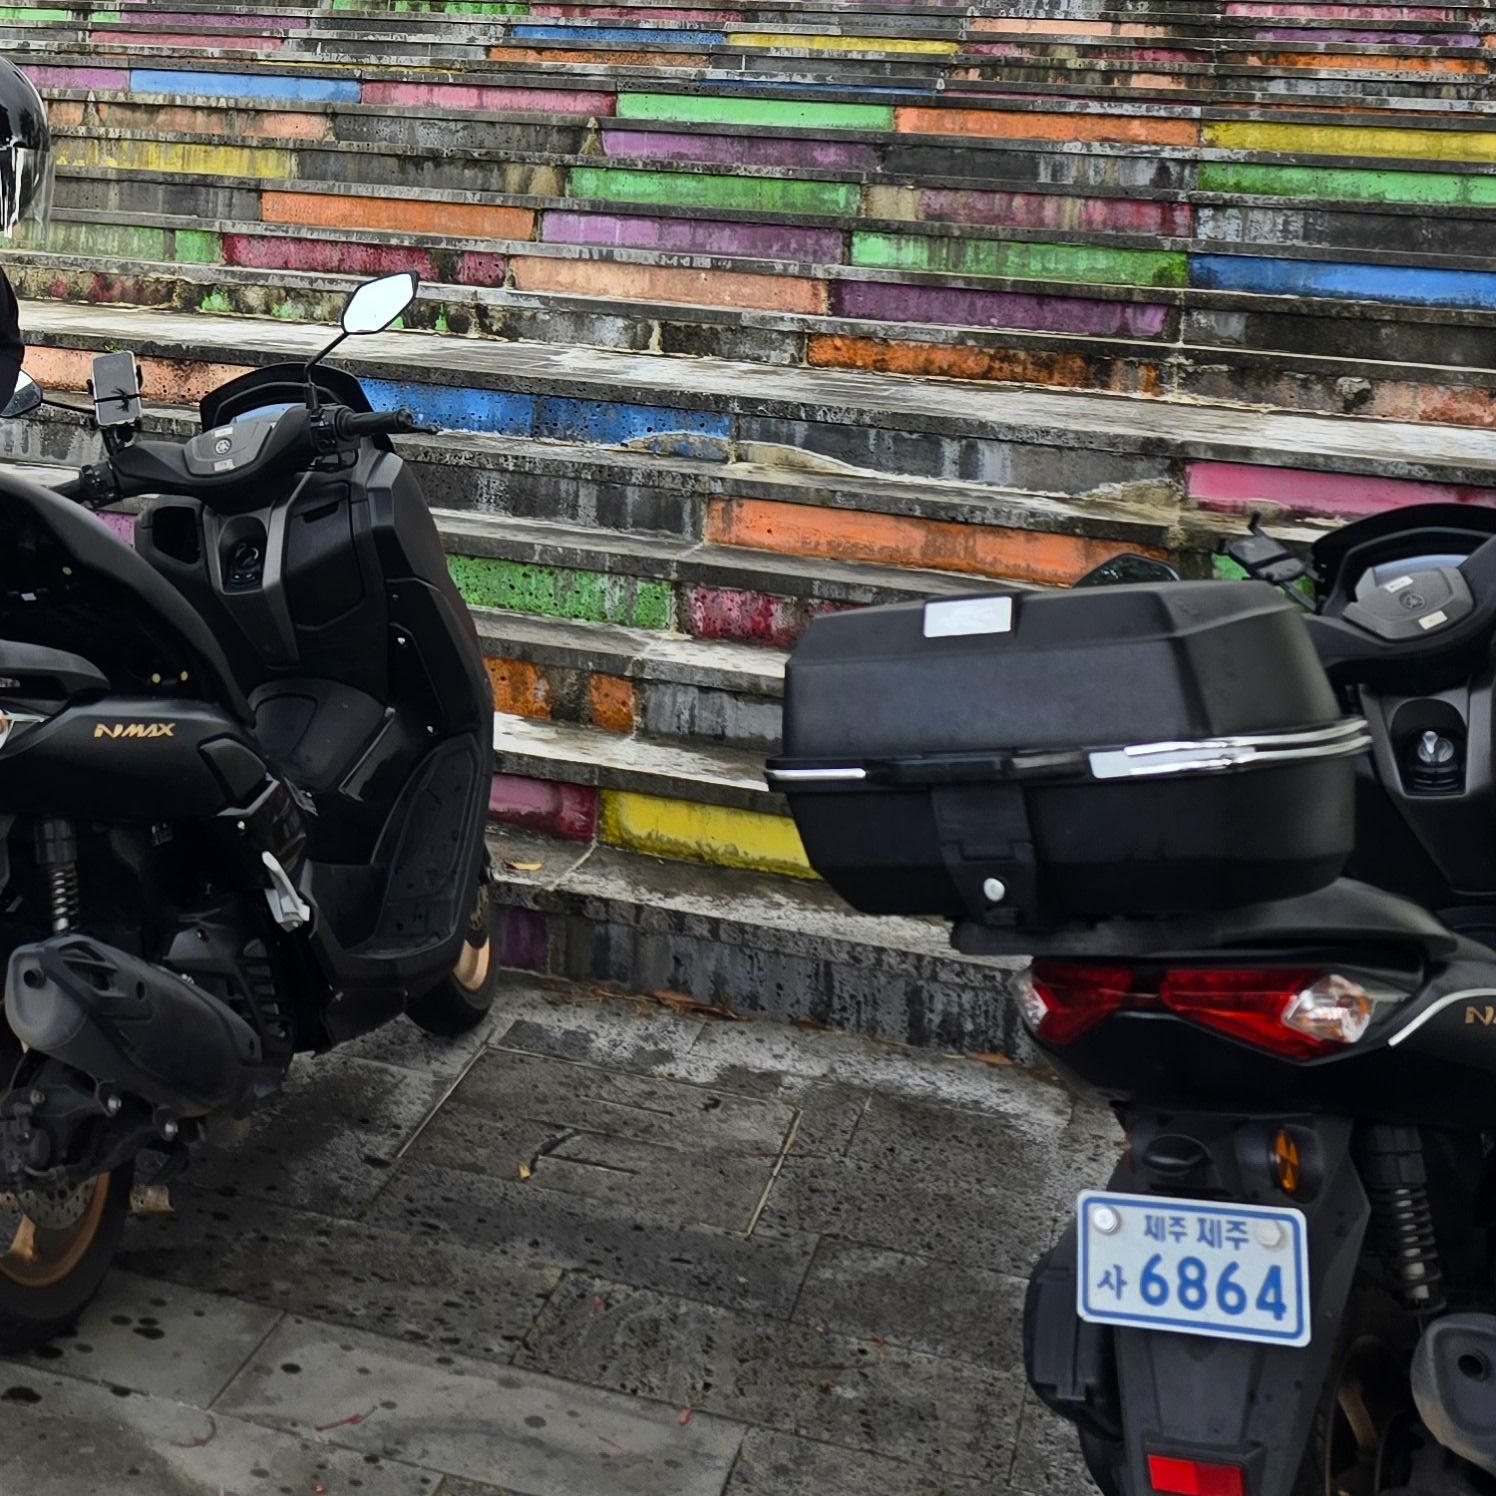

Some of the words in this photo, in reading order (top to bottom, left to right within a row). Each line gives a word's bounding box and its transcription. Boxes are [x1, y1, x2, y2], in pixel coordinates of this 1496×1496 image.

[94, 723, 176, 738] NMAX
[1143, 1213, 1188, 1244] 제주
[1197, 1217, 1250, 1251] 제주
[1097, 1263, 1128, 1301] 사
[1139, 1253, 1288, 1321] 6864
